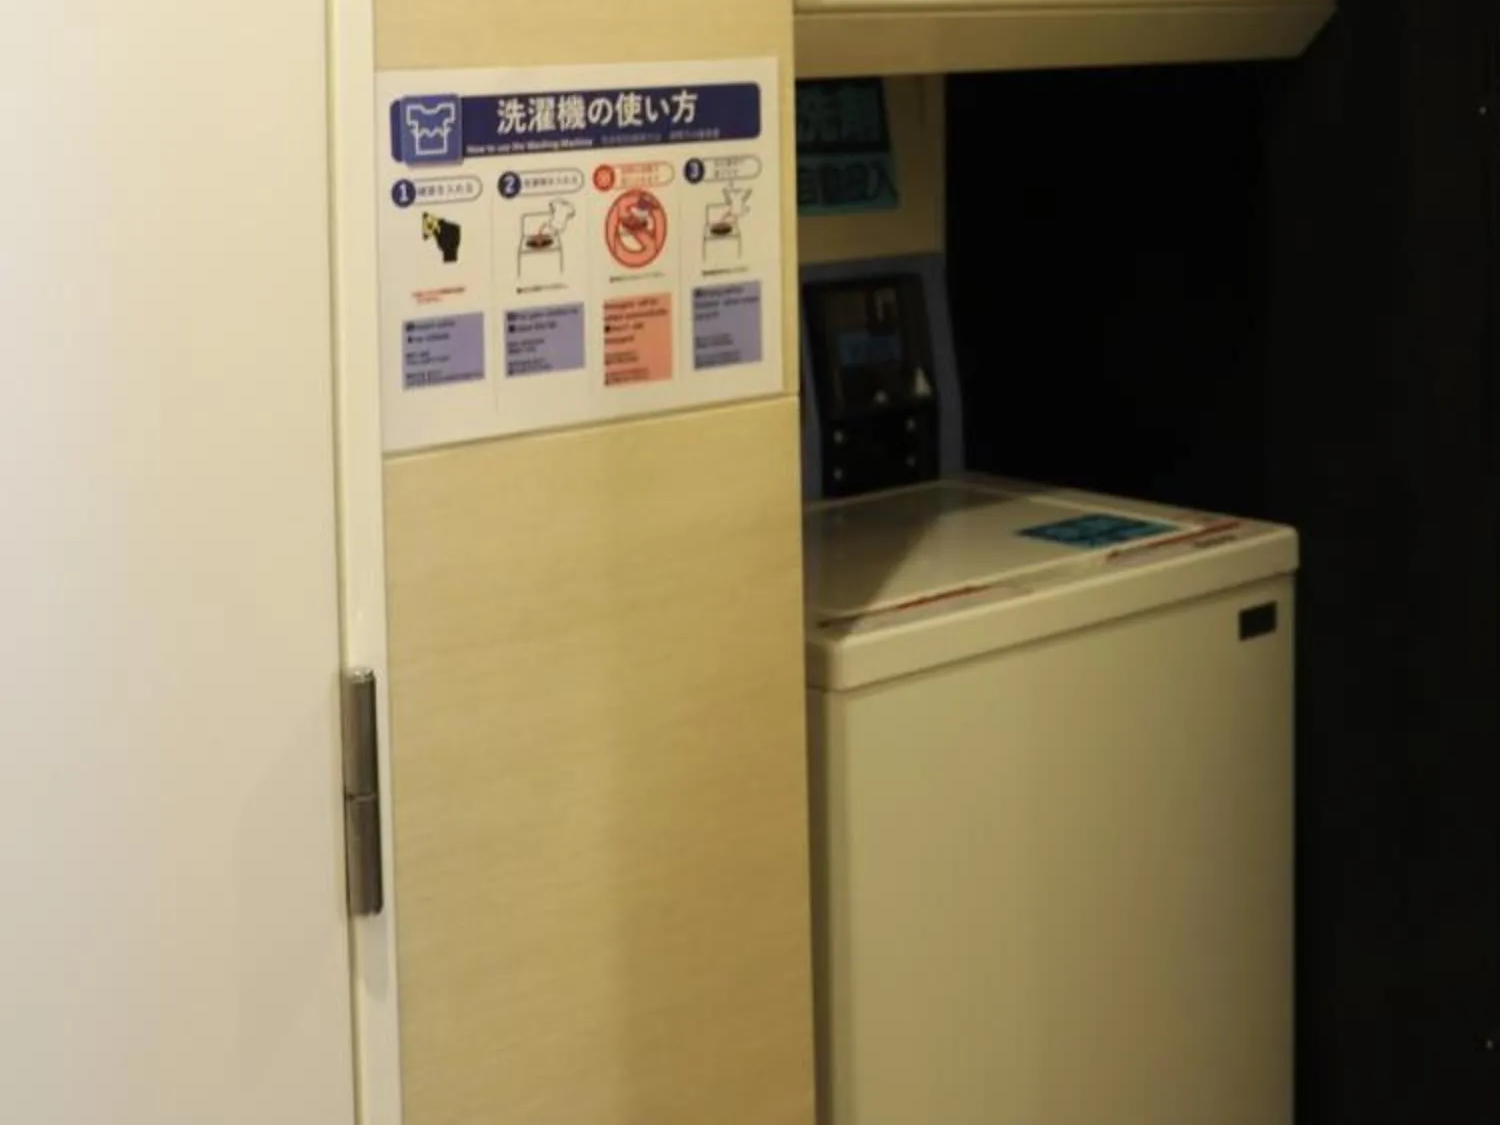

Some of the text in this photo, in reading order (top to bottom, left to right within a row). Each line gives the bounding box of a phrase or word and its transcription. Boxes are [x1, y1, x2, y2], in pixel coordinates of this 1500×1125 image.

[496, 89, 699, 134] 洗濯機の使い方
